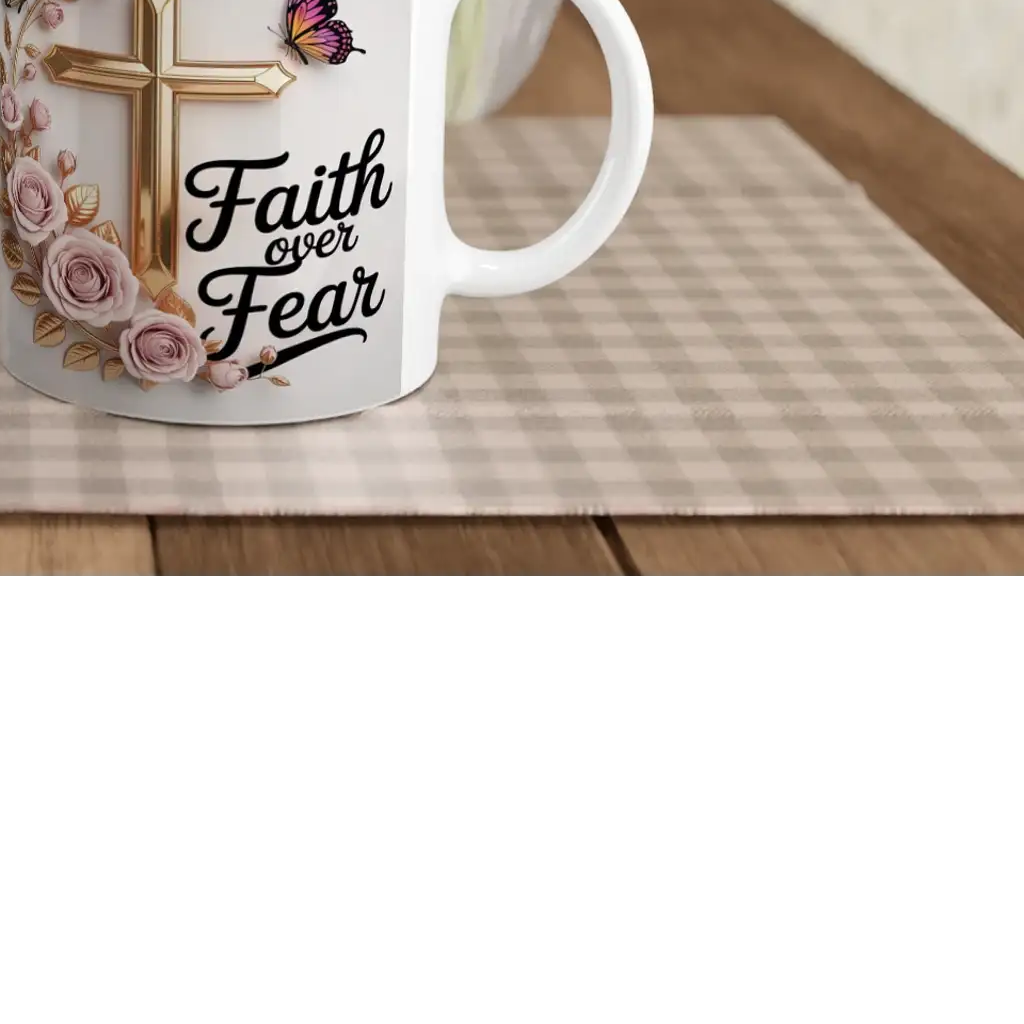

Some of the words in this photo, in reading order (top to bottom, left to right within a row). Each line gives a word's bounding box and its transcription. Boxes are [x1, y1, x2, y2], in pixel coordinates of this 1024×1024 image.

[184, 128, 393, 253] Faith
[264, 221, 359, 266] over
[197, 260, 386, 362] Fear
